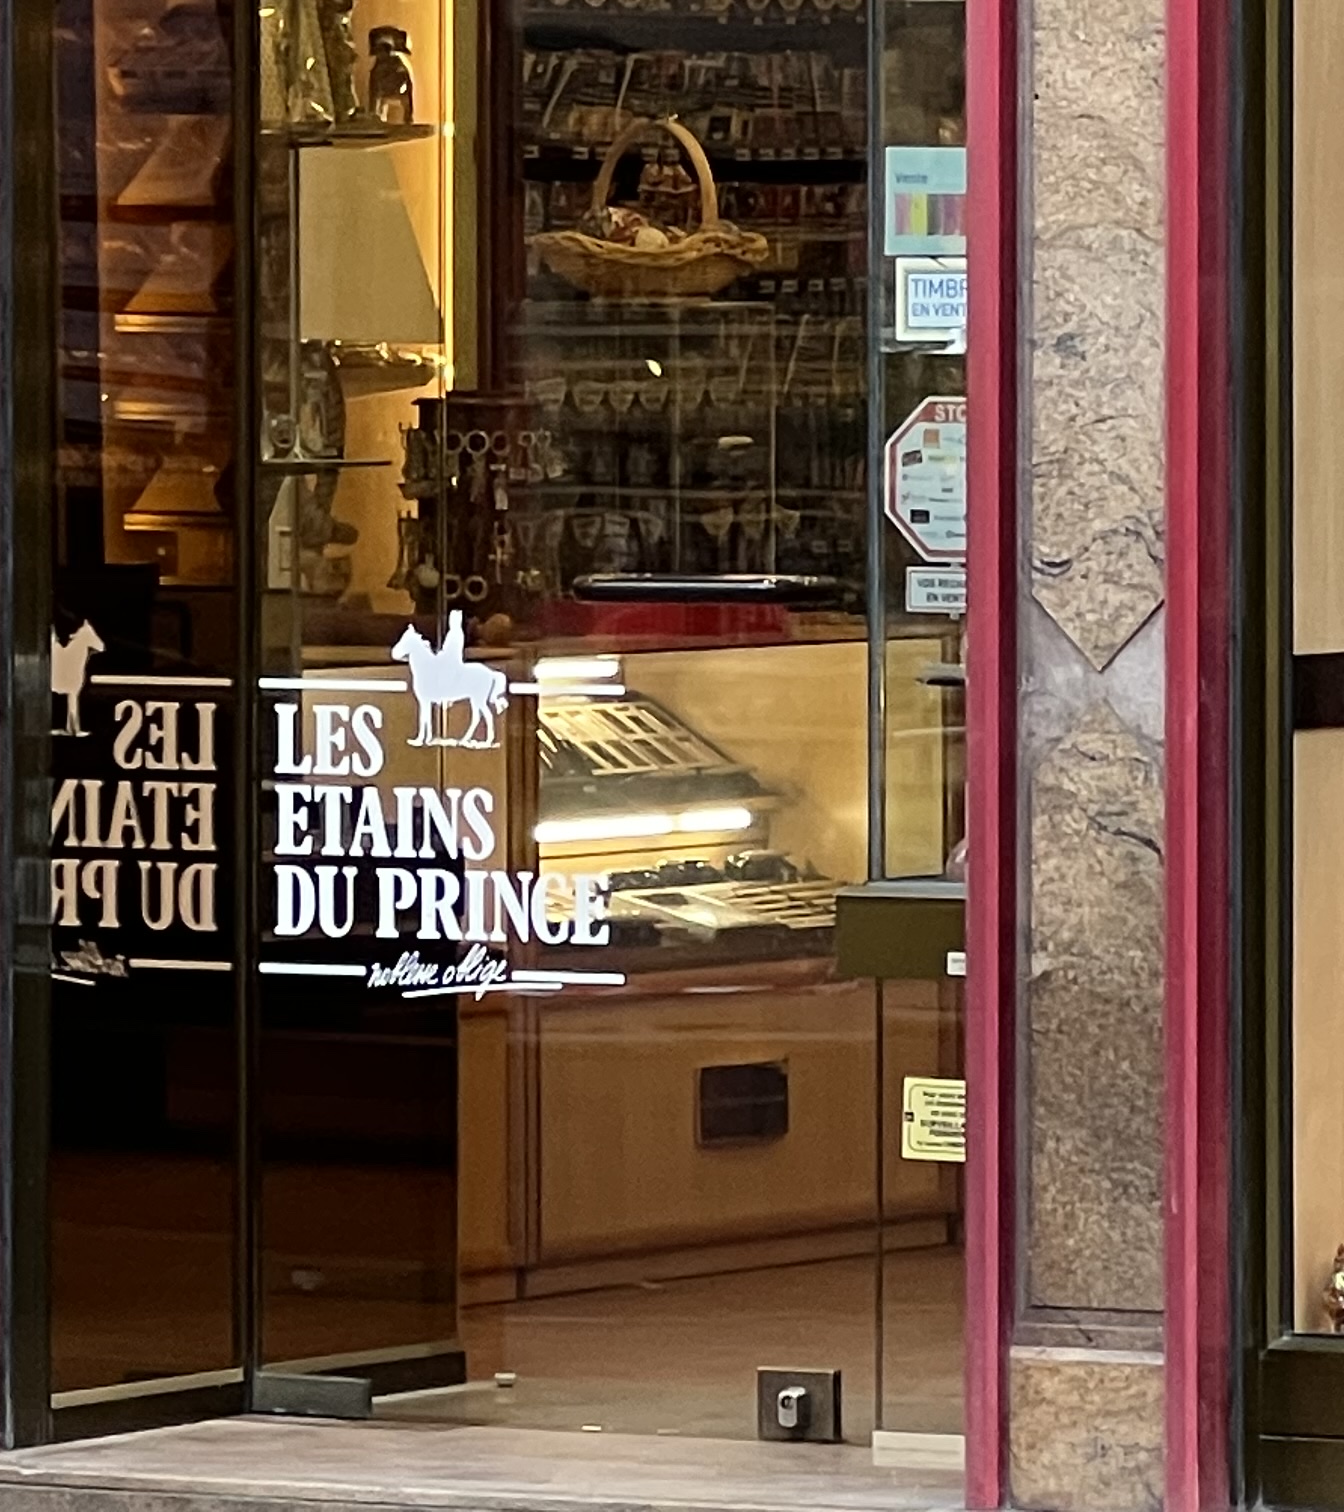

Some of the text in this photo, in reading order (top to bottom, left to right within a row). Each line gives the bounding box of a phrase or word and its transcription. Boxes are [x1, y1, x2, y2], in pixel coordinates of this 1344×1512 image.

[912, 303, 931, 317] EN
[273, 703, 384, 777] LES
[273, 782, 495, 860] ETAINS
[273, 863, 611, 946] DU PRINCE
[442, 943, 508, 1001] oblige
